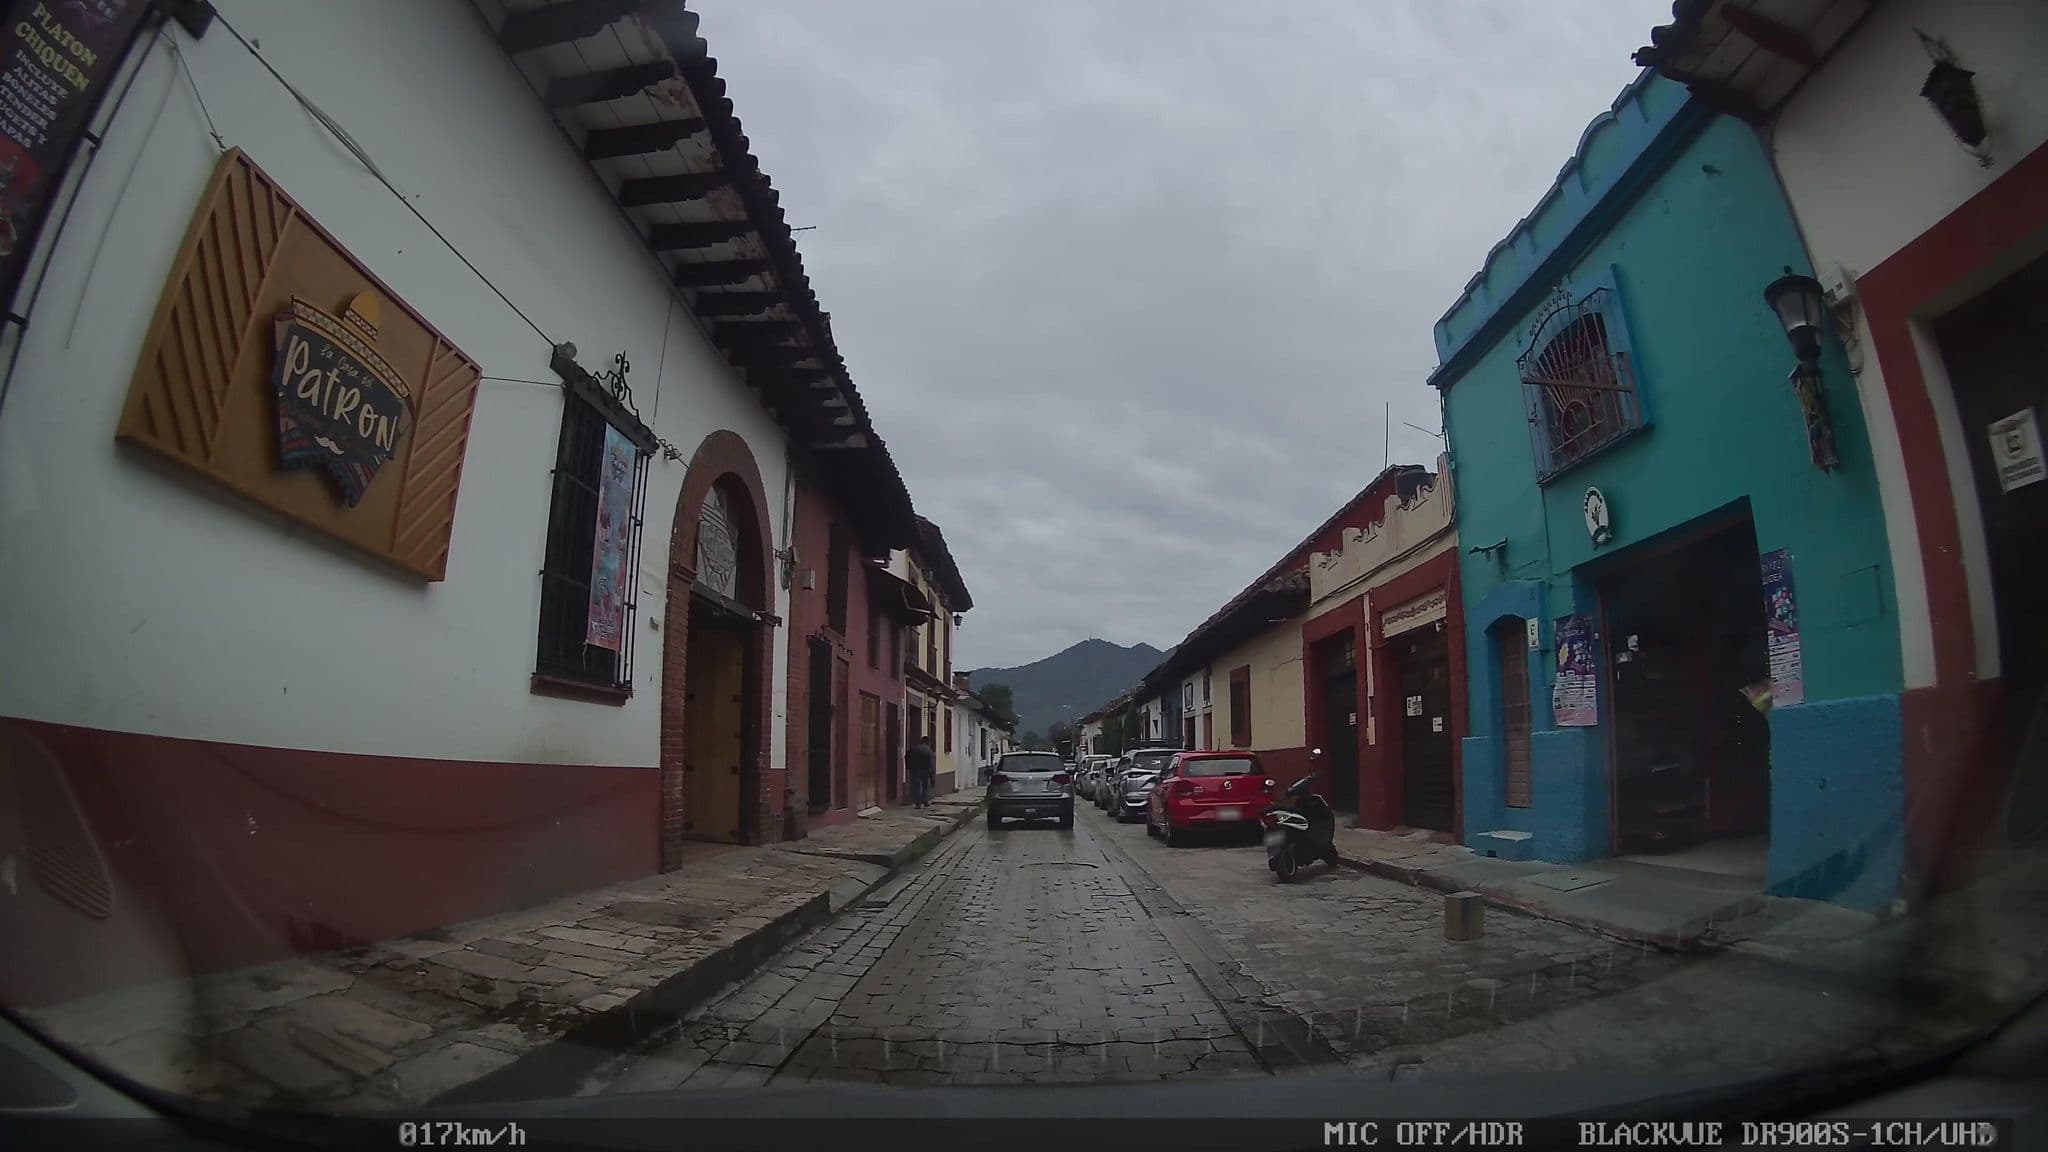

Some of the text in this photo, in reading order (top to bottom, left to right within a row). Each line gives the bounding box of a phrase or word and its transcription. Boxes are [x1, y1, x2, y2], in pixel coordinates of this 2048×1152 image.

[15, 21, 90, 92] CHIQUEN
[32, 2, 97, 67] PLATON
[13, 67, 57, 105] ALITAS
[16, 49, 69, 98] INCLUYE
[0, 117, 32, 148] APAS
